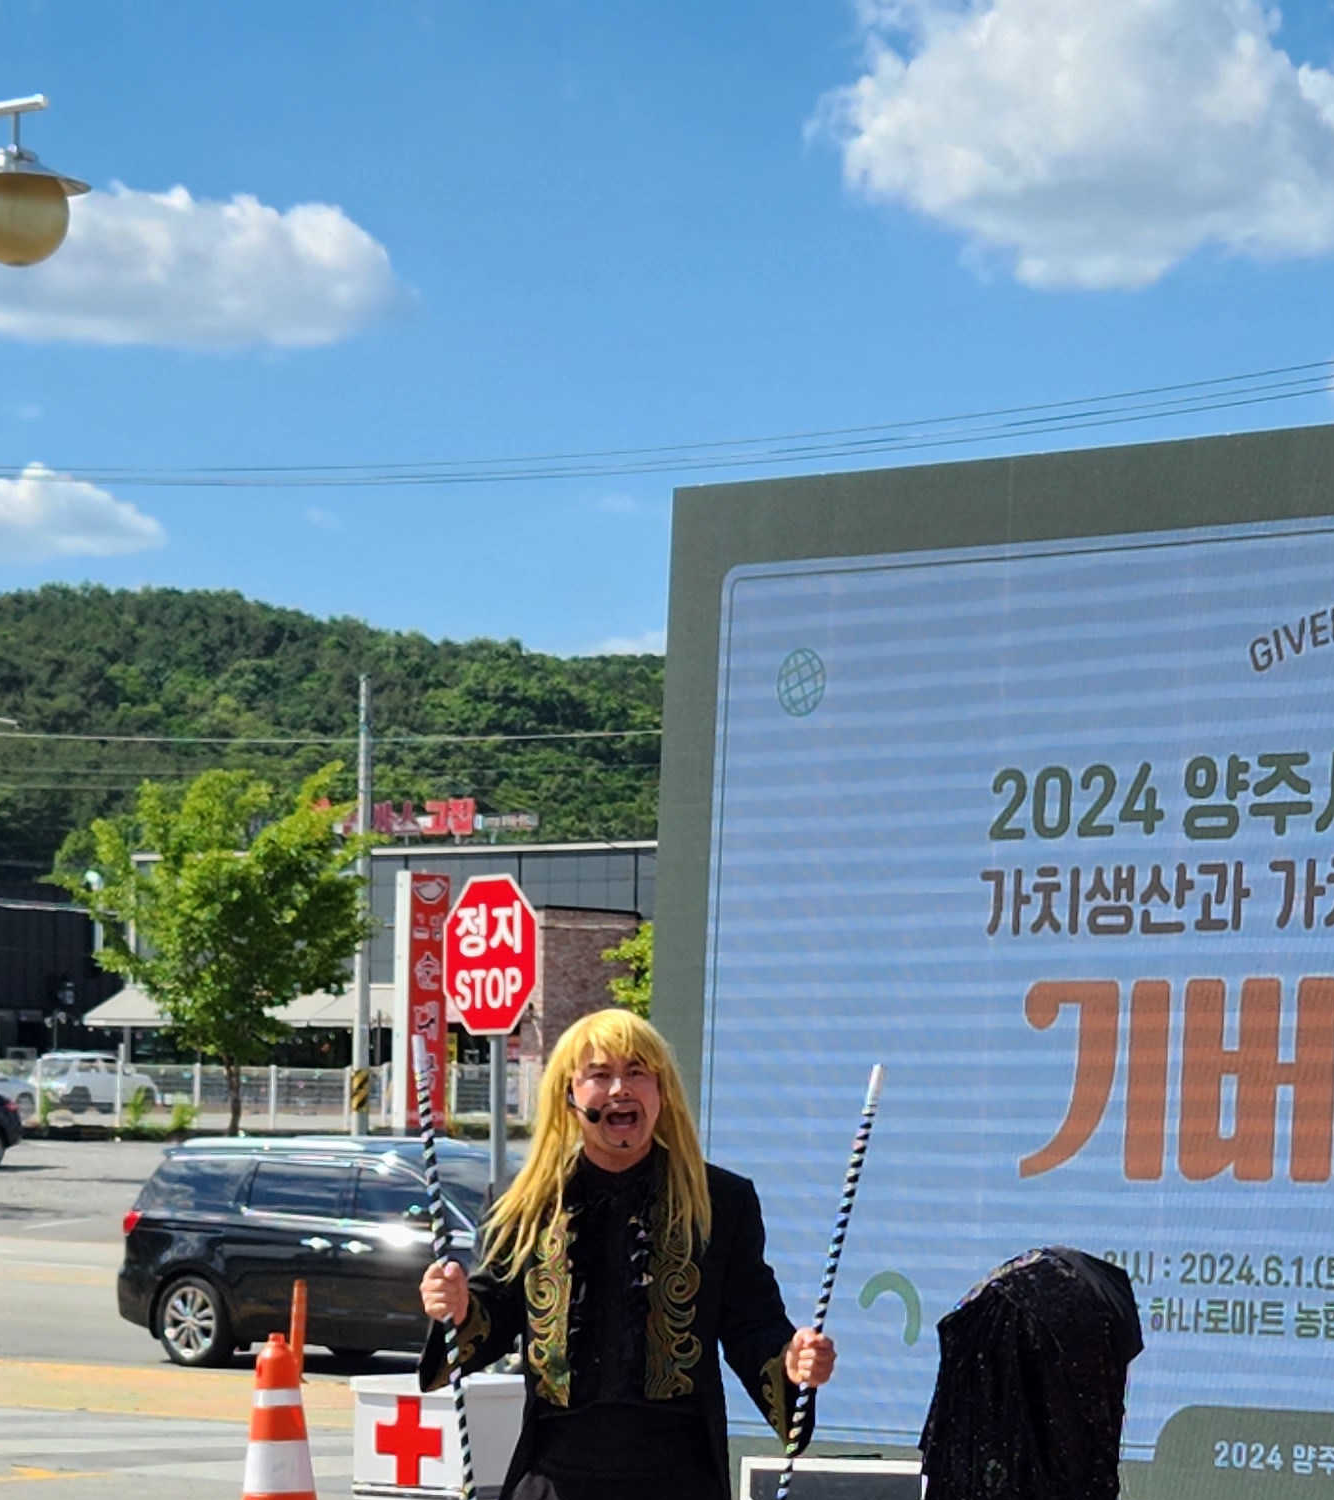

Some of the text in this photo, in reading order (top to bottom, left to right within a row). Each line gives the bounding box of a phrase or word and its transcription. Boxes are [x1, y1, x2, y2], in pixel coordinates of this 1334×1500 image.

[988, 762, 1164, 840] 2024
[980, 861, 1250, 936] 가치생산과
[455, 900, 522, 957] 정지
[455, 967, 522, 1011] STOP
[1149, 1297, 1285, 1336] 하나로마트
[1214, 1440, 1283, 1471] 2024
